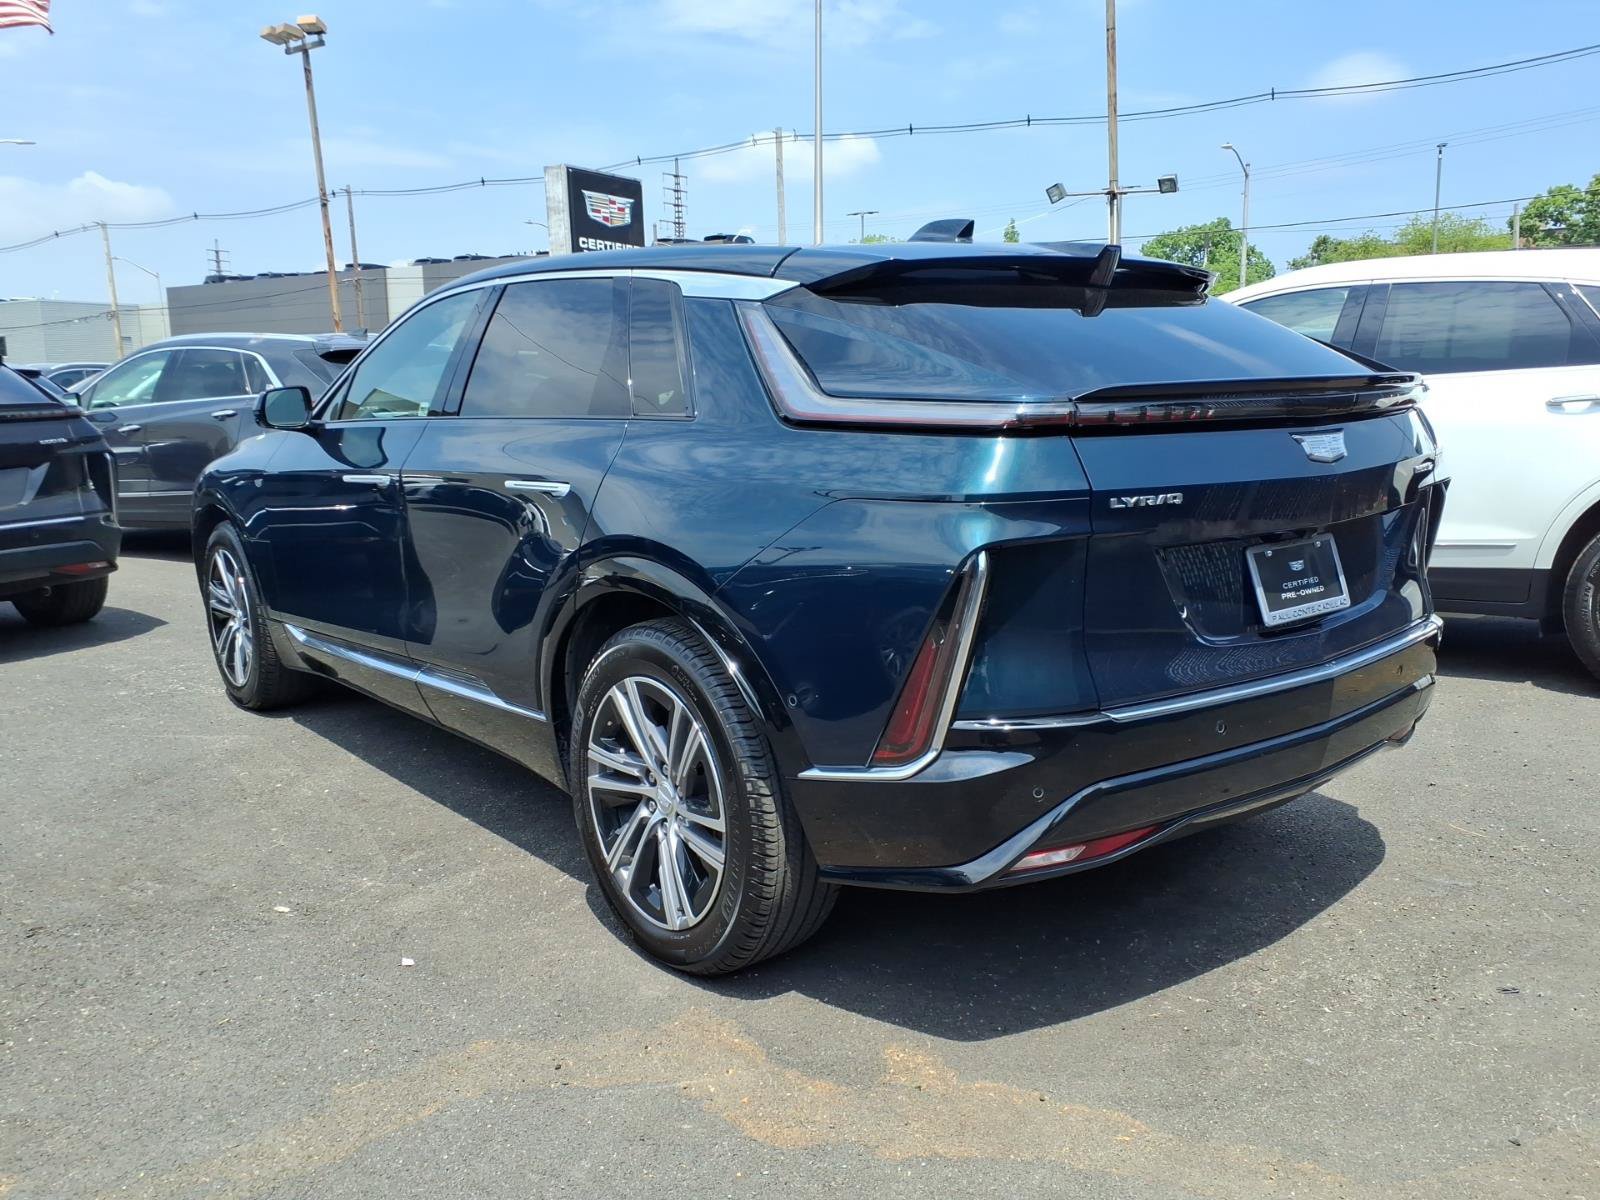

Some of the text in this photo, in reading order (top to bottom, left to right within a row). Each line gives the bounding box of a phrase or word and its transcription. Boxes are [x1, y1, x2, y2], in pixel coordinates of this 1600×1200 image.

[579, 237, 640, 250] CERTIFI
[1110, 493, 1183, 508] LYRIQ
[1282, 576, 1319, 589] CERTIFIED
[1281, 585, 1325, 600] PRE-OWNED
